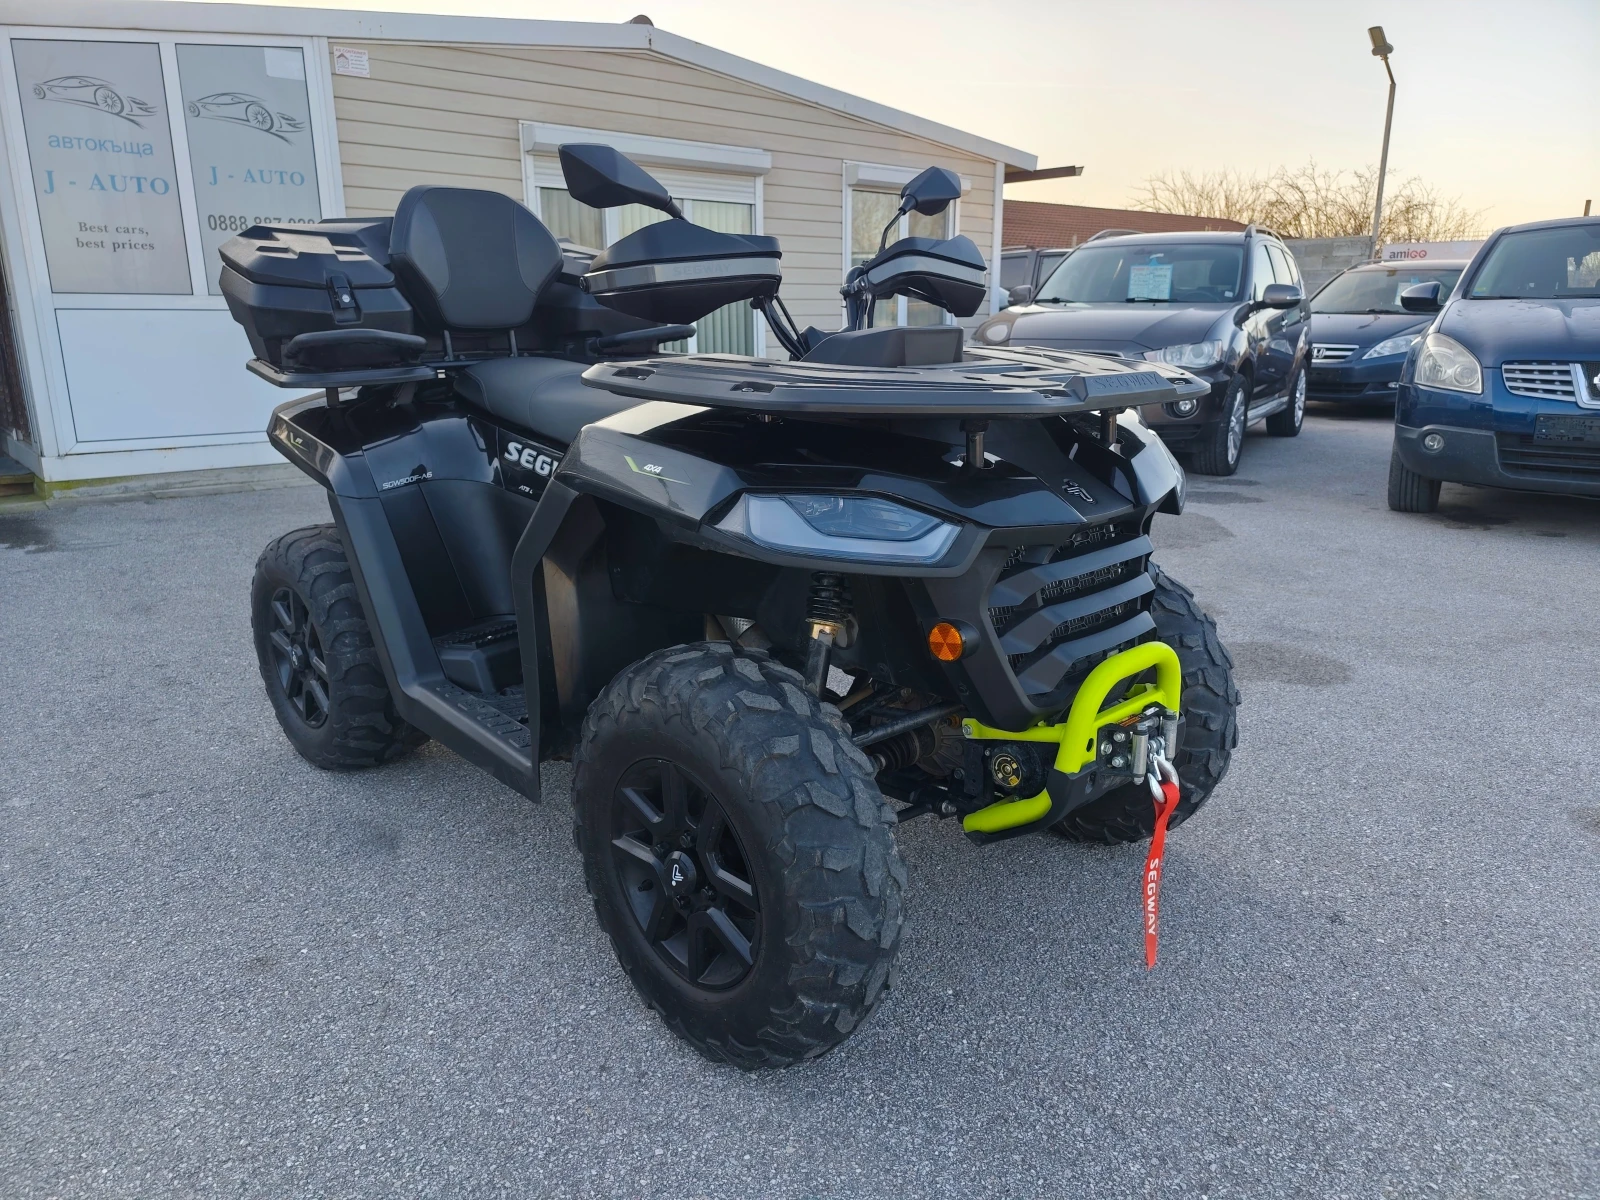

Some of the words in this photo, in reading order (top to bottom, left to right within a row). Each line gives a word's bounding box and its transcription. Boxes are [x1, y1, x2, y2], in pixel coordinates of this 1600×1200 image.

[48, 134, 154, 158] автокъща
[44, 170, 55, 194] J
[88, 173, 170, 195] AUTO
[209, 166, 218, 186] J
[243, 168, 305, 186] AUTO
[78, 221, 109, 233] Best
[115, 225, 149, 236] cars,
[207, 214, 248, 231] 0888
[76, 238, 106, 248] best
[112, 239, 155, 252] prices
[1095, 373, 1159, 390] SEGWAY
[1147, 858, 1159, 935] SEGWAY
